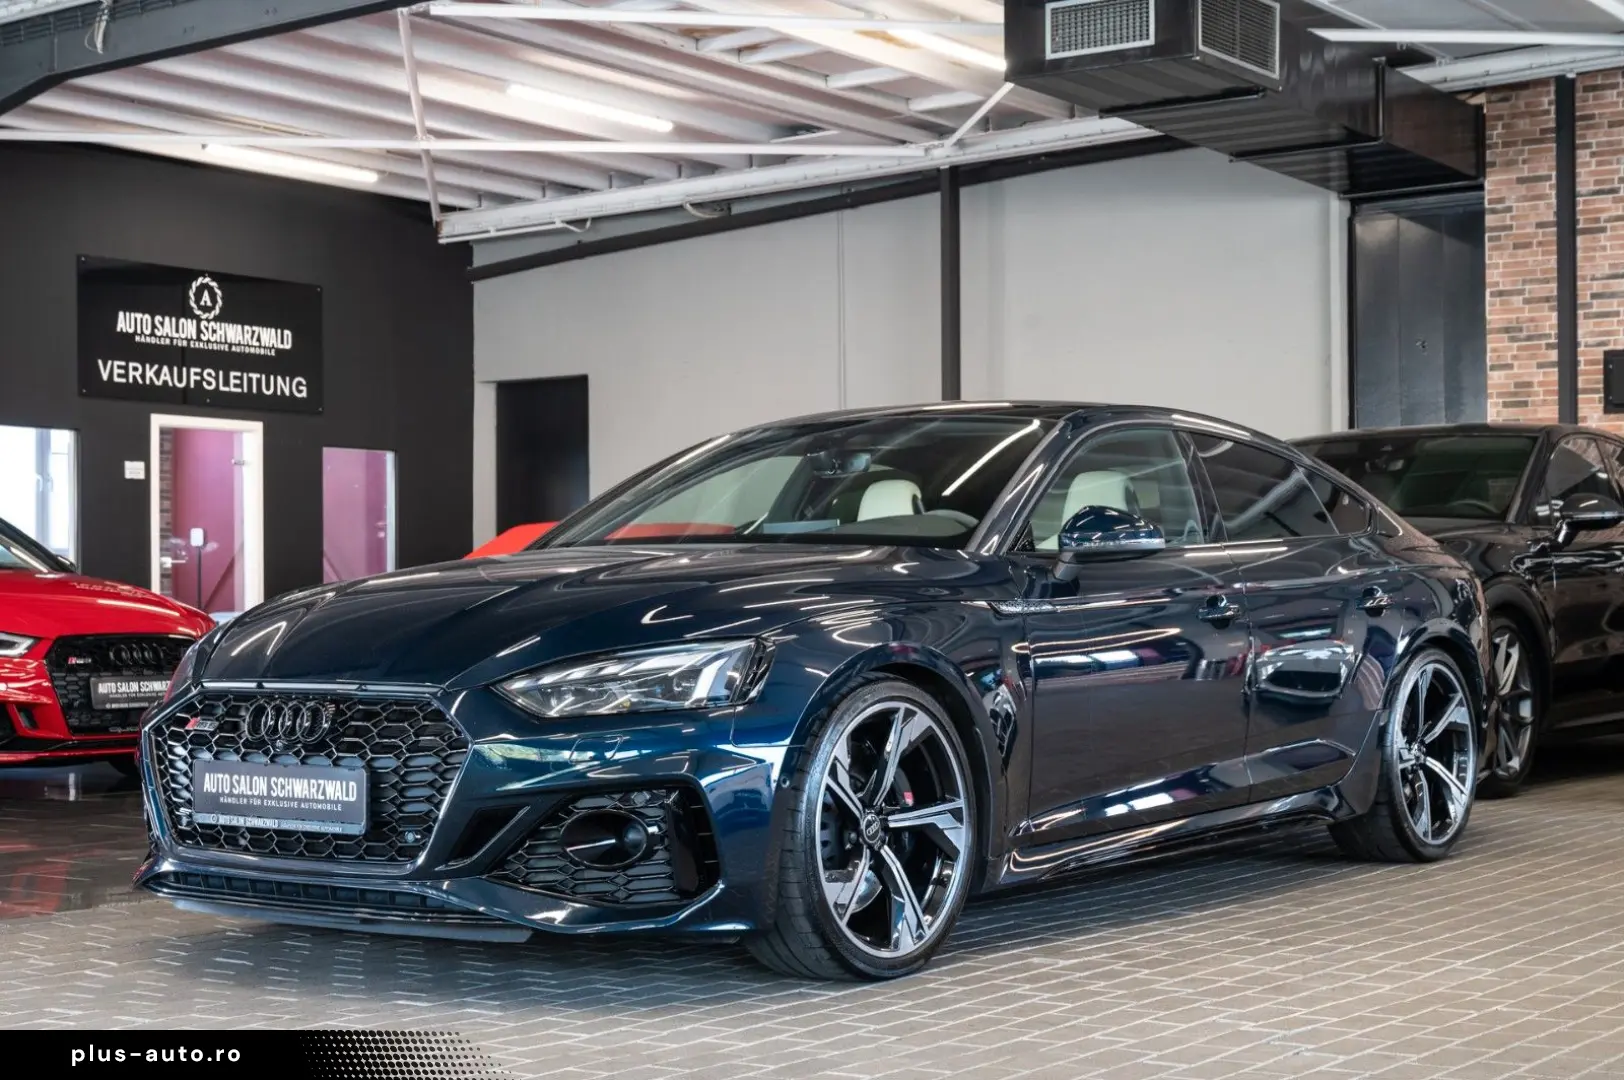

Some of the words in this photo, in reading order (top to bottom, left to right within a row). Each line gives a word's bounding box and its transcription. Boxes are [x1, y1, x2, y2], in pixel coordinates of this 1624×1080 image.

[200, 289, 212, 307] A
[116, 310, 152, 336] AUTO
[154, 315, 197, 339] SALON
[199, 319, 293, 350] SCHWARZWALD
[135, 334, 171, 346] HÄNDLER
[173, 337, 187, 347] FÜR
[190, 340, 229, 352] EXKLUSIVE
[231, 344, 276, 356] AUTOMOBILE
[97, 358, 308, 398] VERKAUFSLEITUNG
[98, 683, 116, 693] AUTO
[117, 681, 139, 693] SALON
[140, 680, 171, 692] SCHWARZ
[203, 772, 230, 794] AUTO
[232, 775, 268, 798] SALON
[270, 776, 357, 802] SCHWARZWALD
[249, 797, 262, 807] FÜR
[263, 799, 298, 808] EXKLUSIVE
[301, 802, 342, 811] AUTOMOBILE
